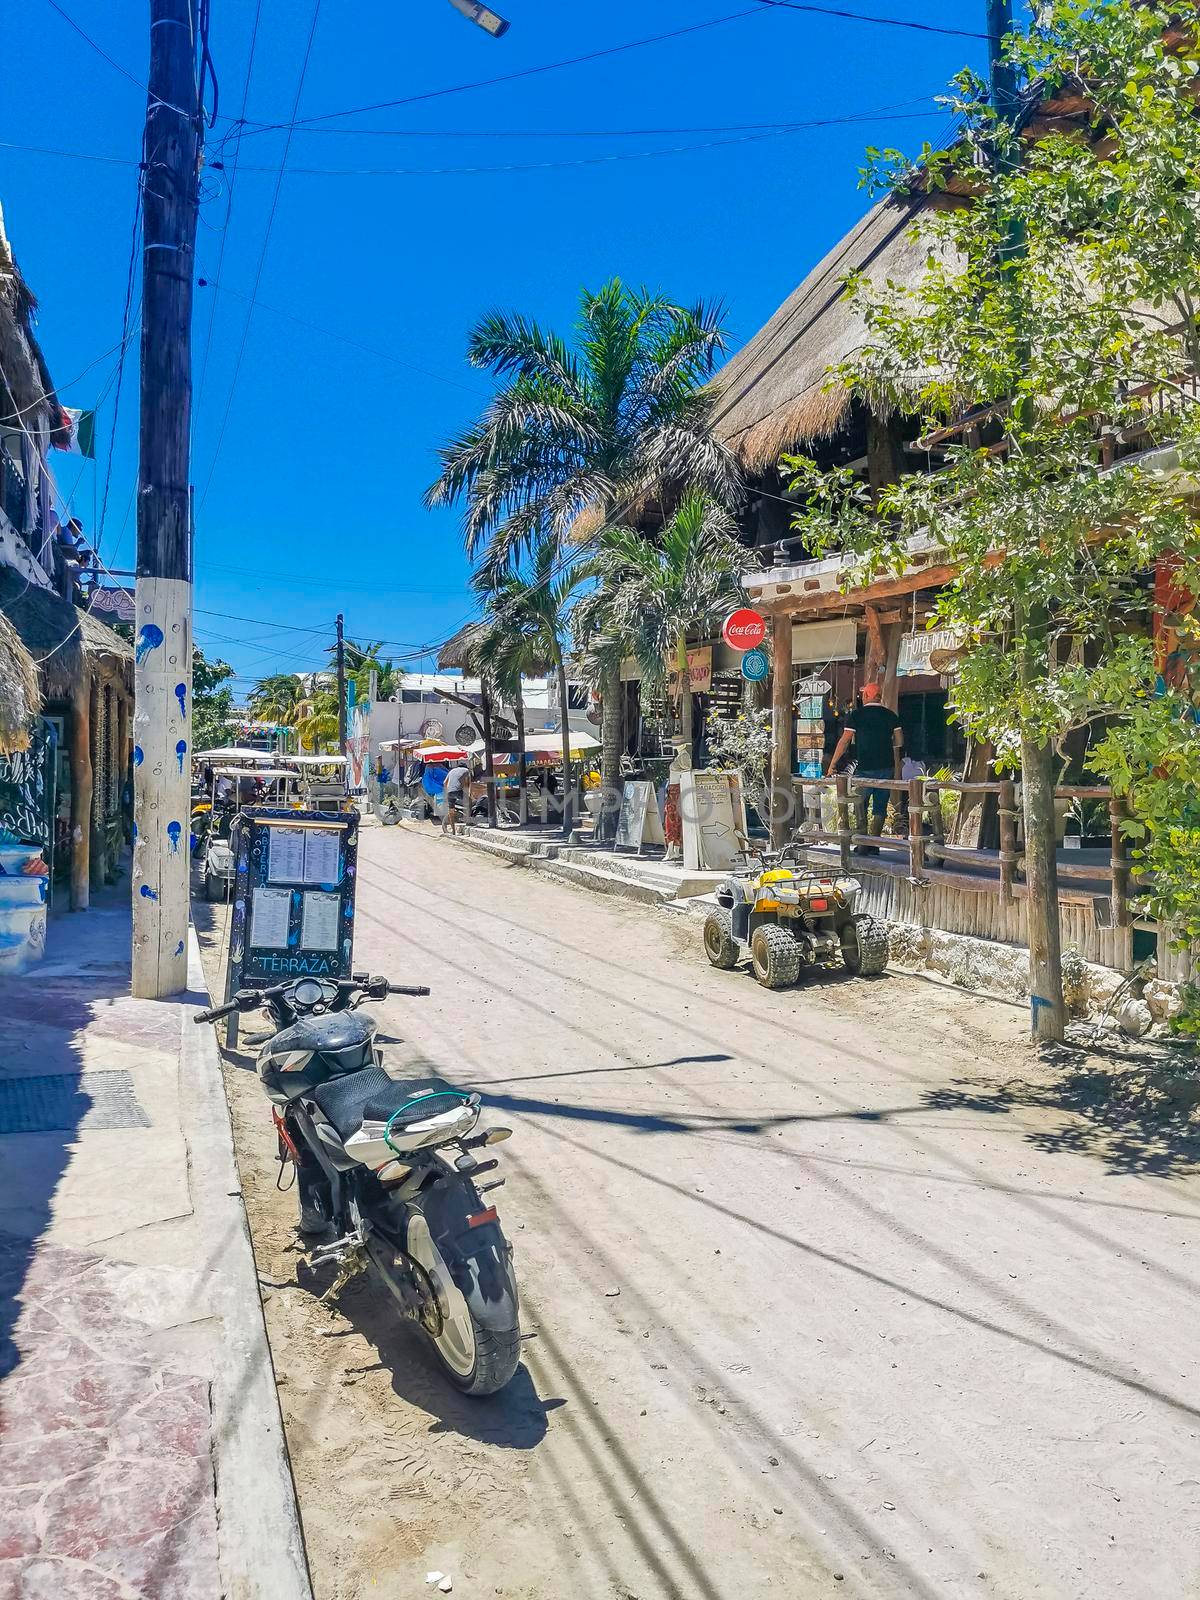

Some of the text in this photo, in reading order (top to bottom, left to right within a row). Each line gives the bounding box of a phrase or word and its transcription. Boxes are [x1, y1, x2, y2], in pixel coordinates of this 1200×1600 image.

[729, 623, 762, 635] Coca-Cola
[905, 636, 930, 662] HOTEL
[803, 683, 826, 692] ATM
[258, 956, 329, 973] TERRAZA
